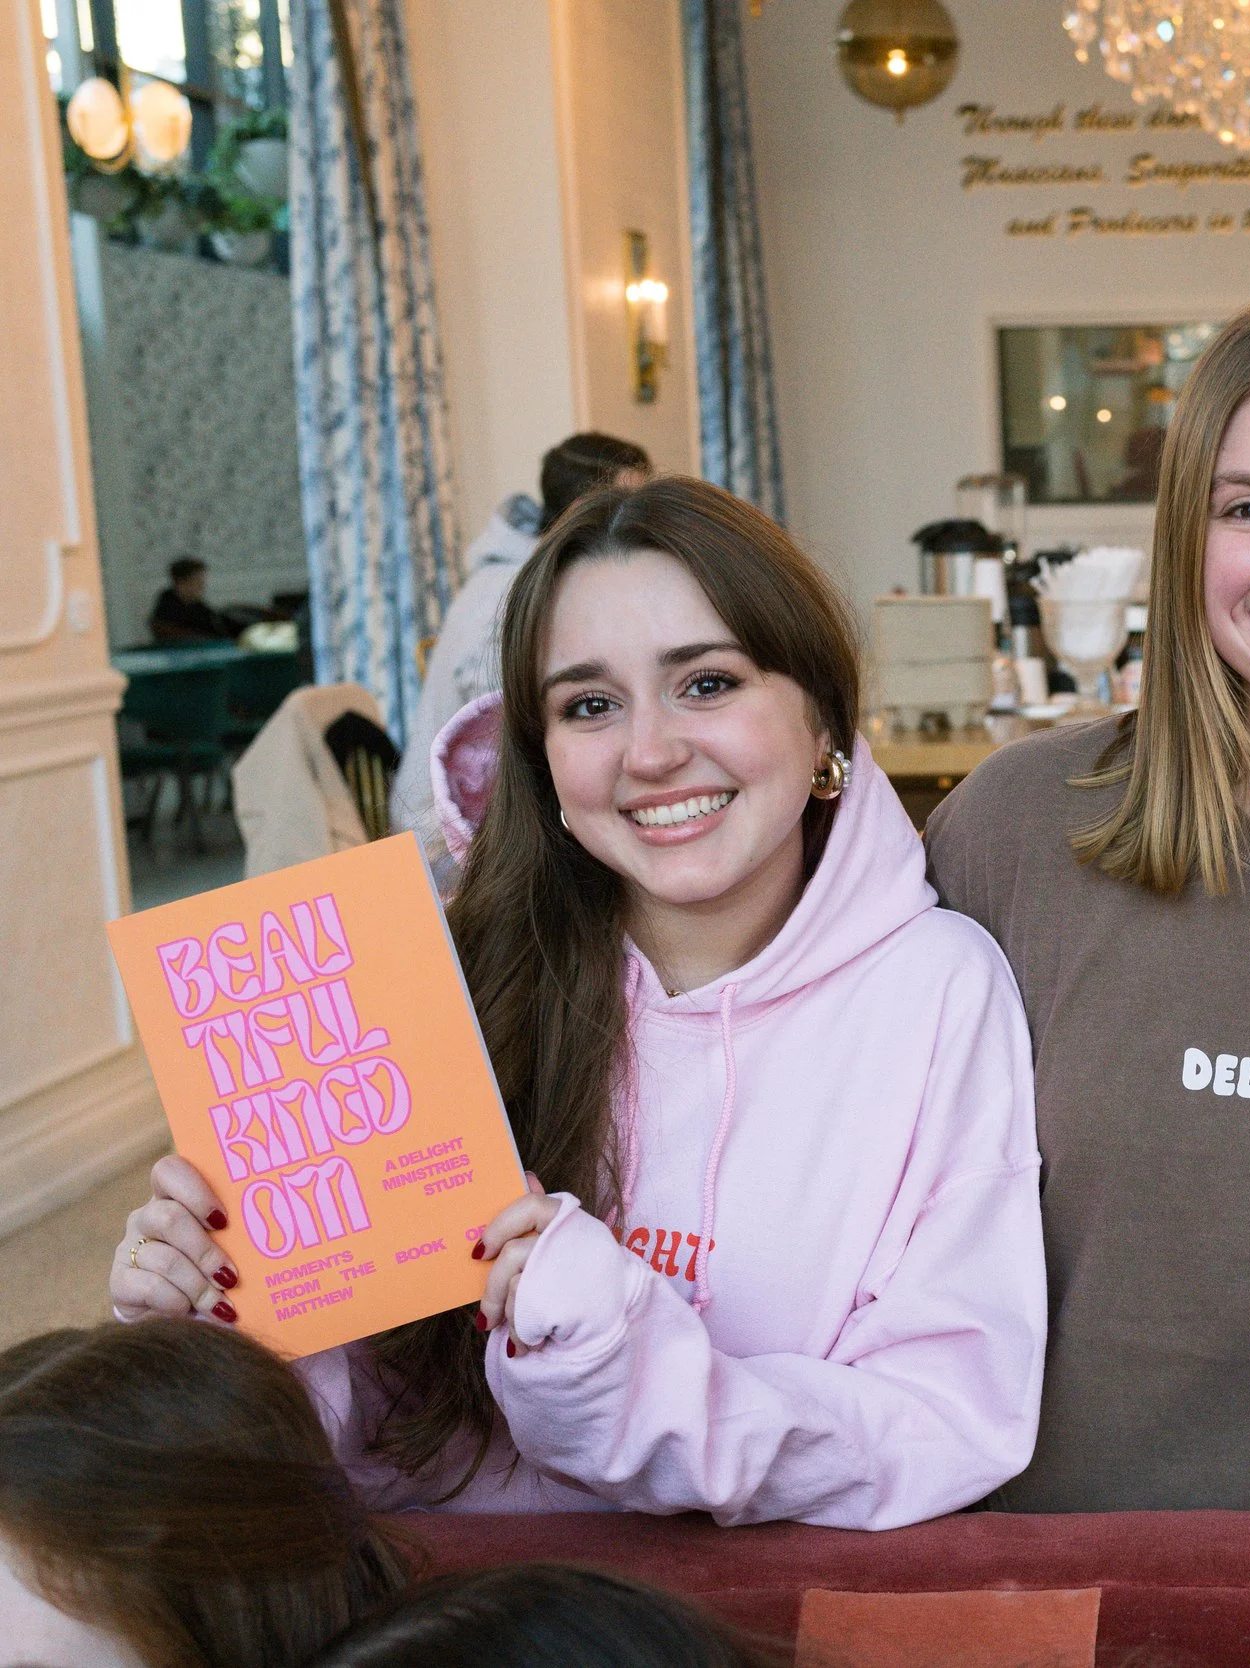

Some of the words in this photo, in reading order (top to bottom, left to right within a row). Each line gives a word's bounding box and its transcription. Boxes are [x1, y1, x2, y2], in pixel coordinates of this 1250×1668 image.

[957, 103, 1066, 144] Through
[1005, 209, 1056, 237] and
[1065, 206, 1200, 238] Producers
[1207, 211, 1236, 232] in
[157, 893, 355, 1020] BEAU
[182, 978, 391, 1096] TIFUL
[208, 1055, 412, 1184] KINGD
[382, 1154, 471, 1191] MINISTRIES
[385, 1160, 397, 1173] A
[397, 1137, 464, 1169] DELIGHT
[423, 1170, 474, 1196] STUDY
[241, 1156, 374, 1260] OM
[264, 1250, 354, 1288] MOMENTS
[270, 1279, 321, 1304] FROM
[339, 1261, 377, 1282] THE
[394, 1238, 447, 1264] BOOK
[275, 1287, 353, 1321] MATTHEW
